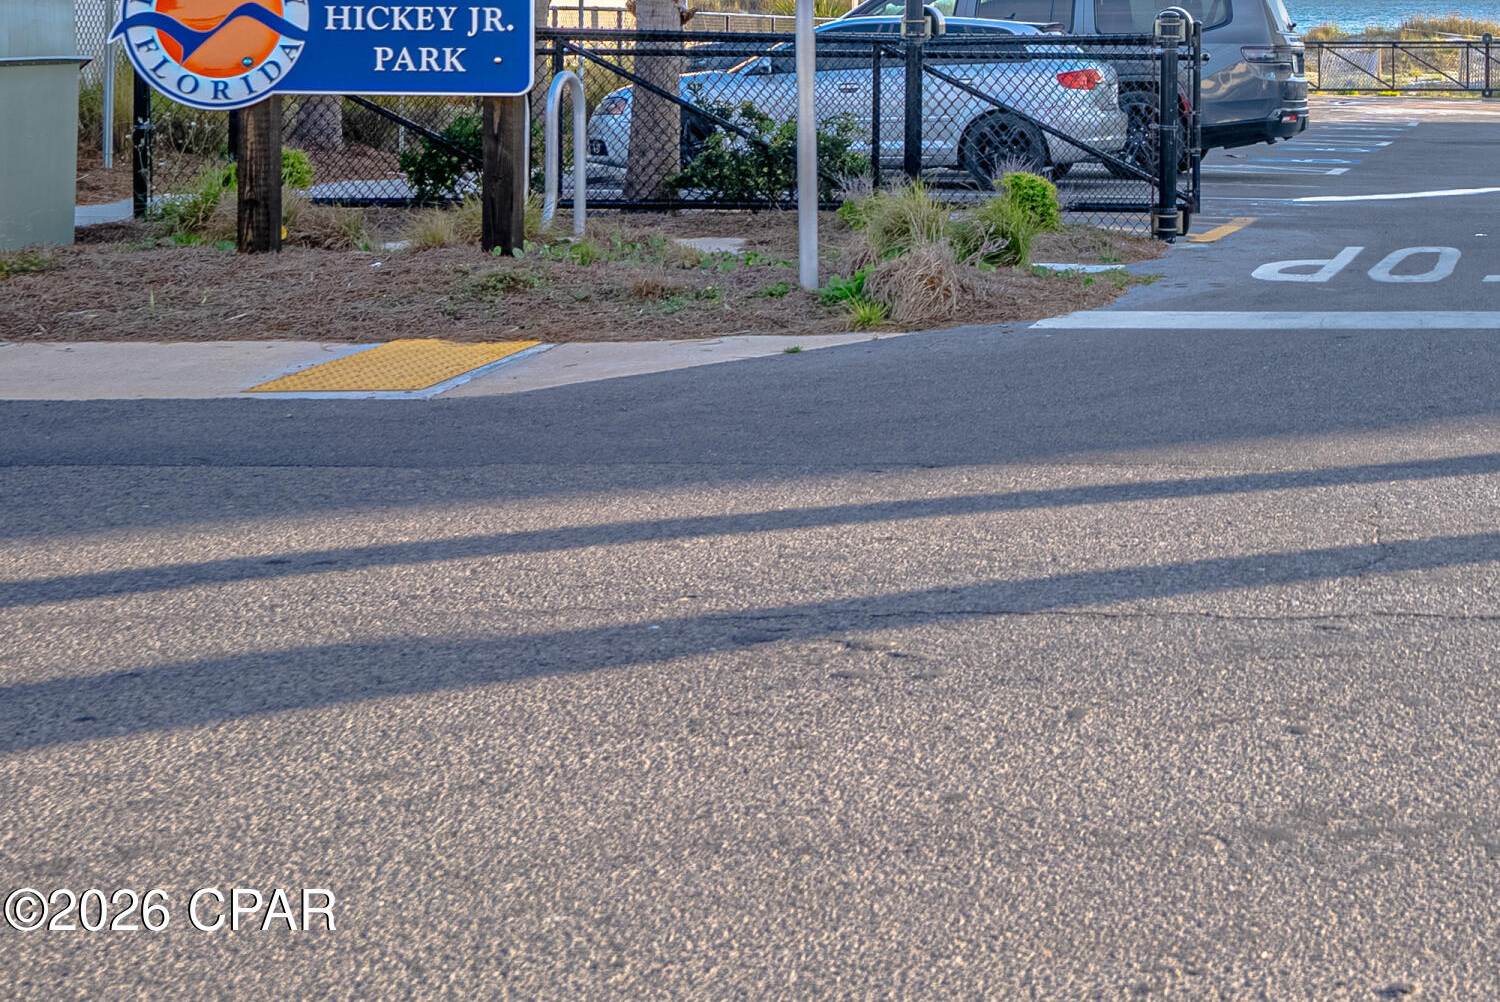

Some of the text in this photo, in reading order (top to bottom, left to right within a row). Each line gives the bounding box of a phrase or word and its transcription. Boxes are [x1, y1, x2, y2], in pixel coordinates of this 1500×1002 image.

[324, 5, 515, 38] HICKEY JR.
[134, 35, 302, 100] FLORIDA
[373, 46, 467, 73] PARK
